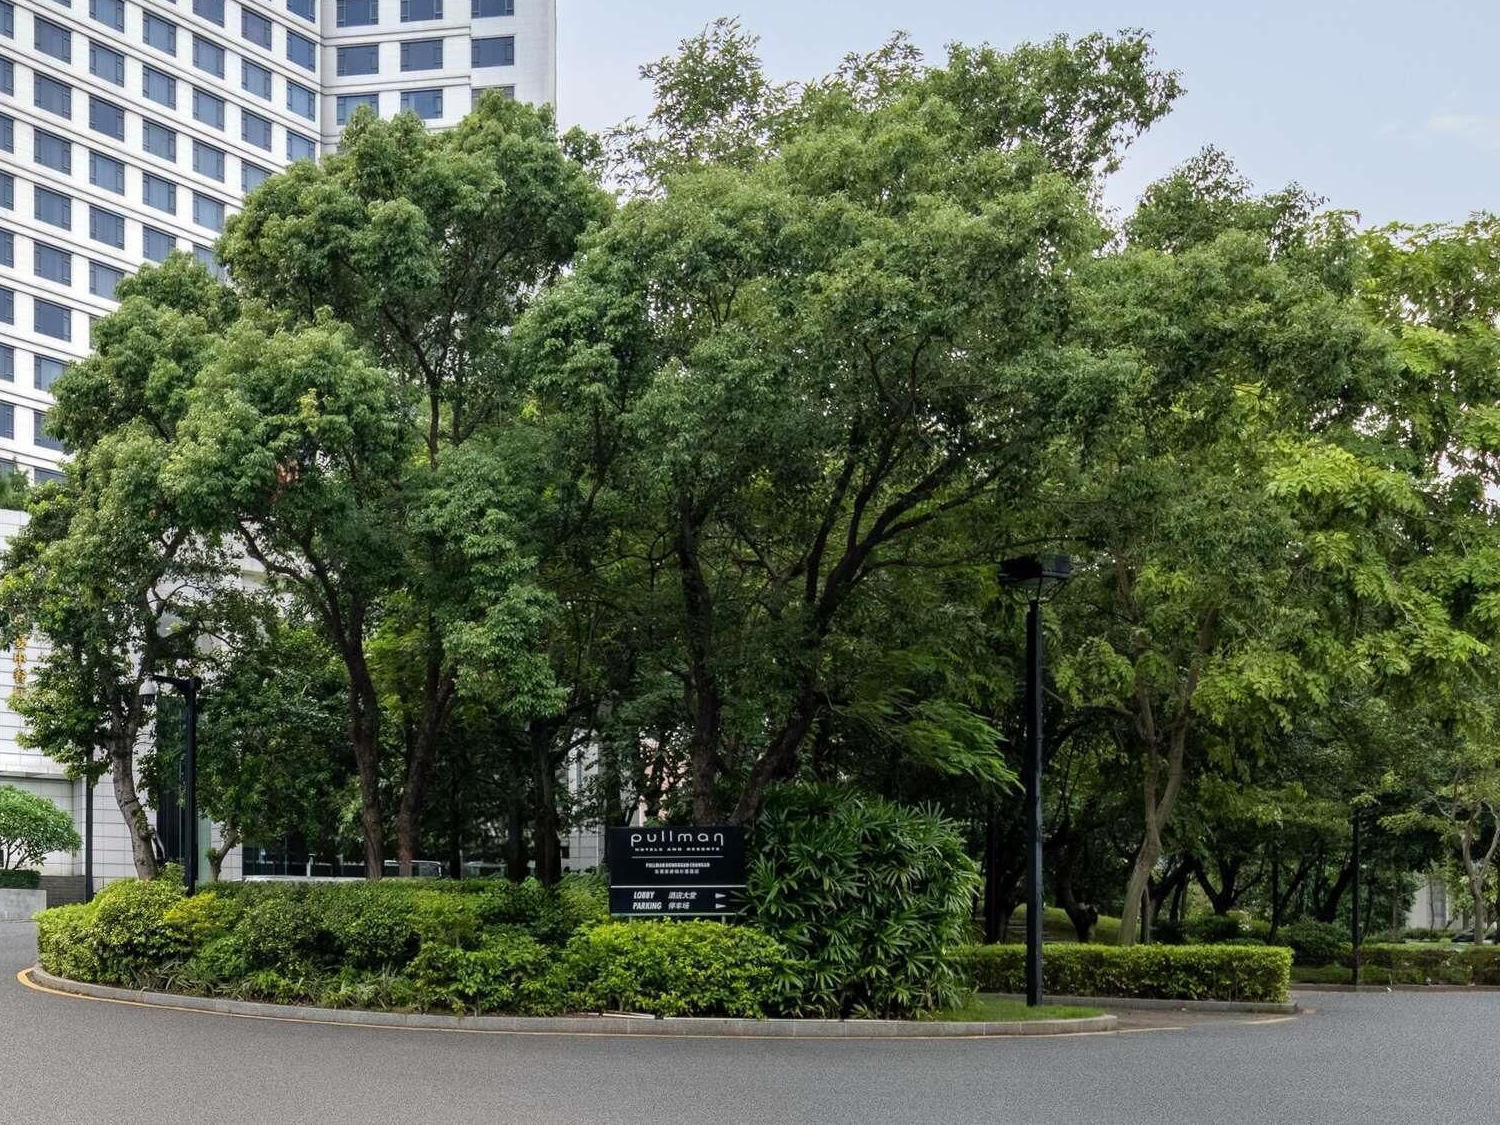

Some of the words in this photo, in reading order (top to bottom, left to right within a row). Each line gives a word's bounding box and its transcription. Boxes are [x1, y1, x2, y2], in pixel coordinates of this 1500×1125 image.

[630, 830, 724, 847] pullman
[633, 891, 655, 899] LOBBY
[632, 902, 662, 910] PARKING
